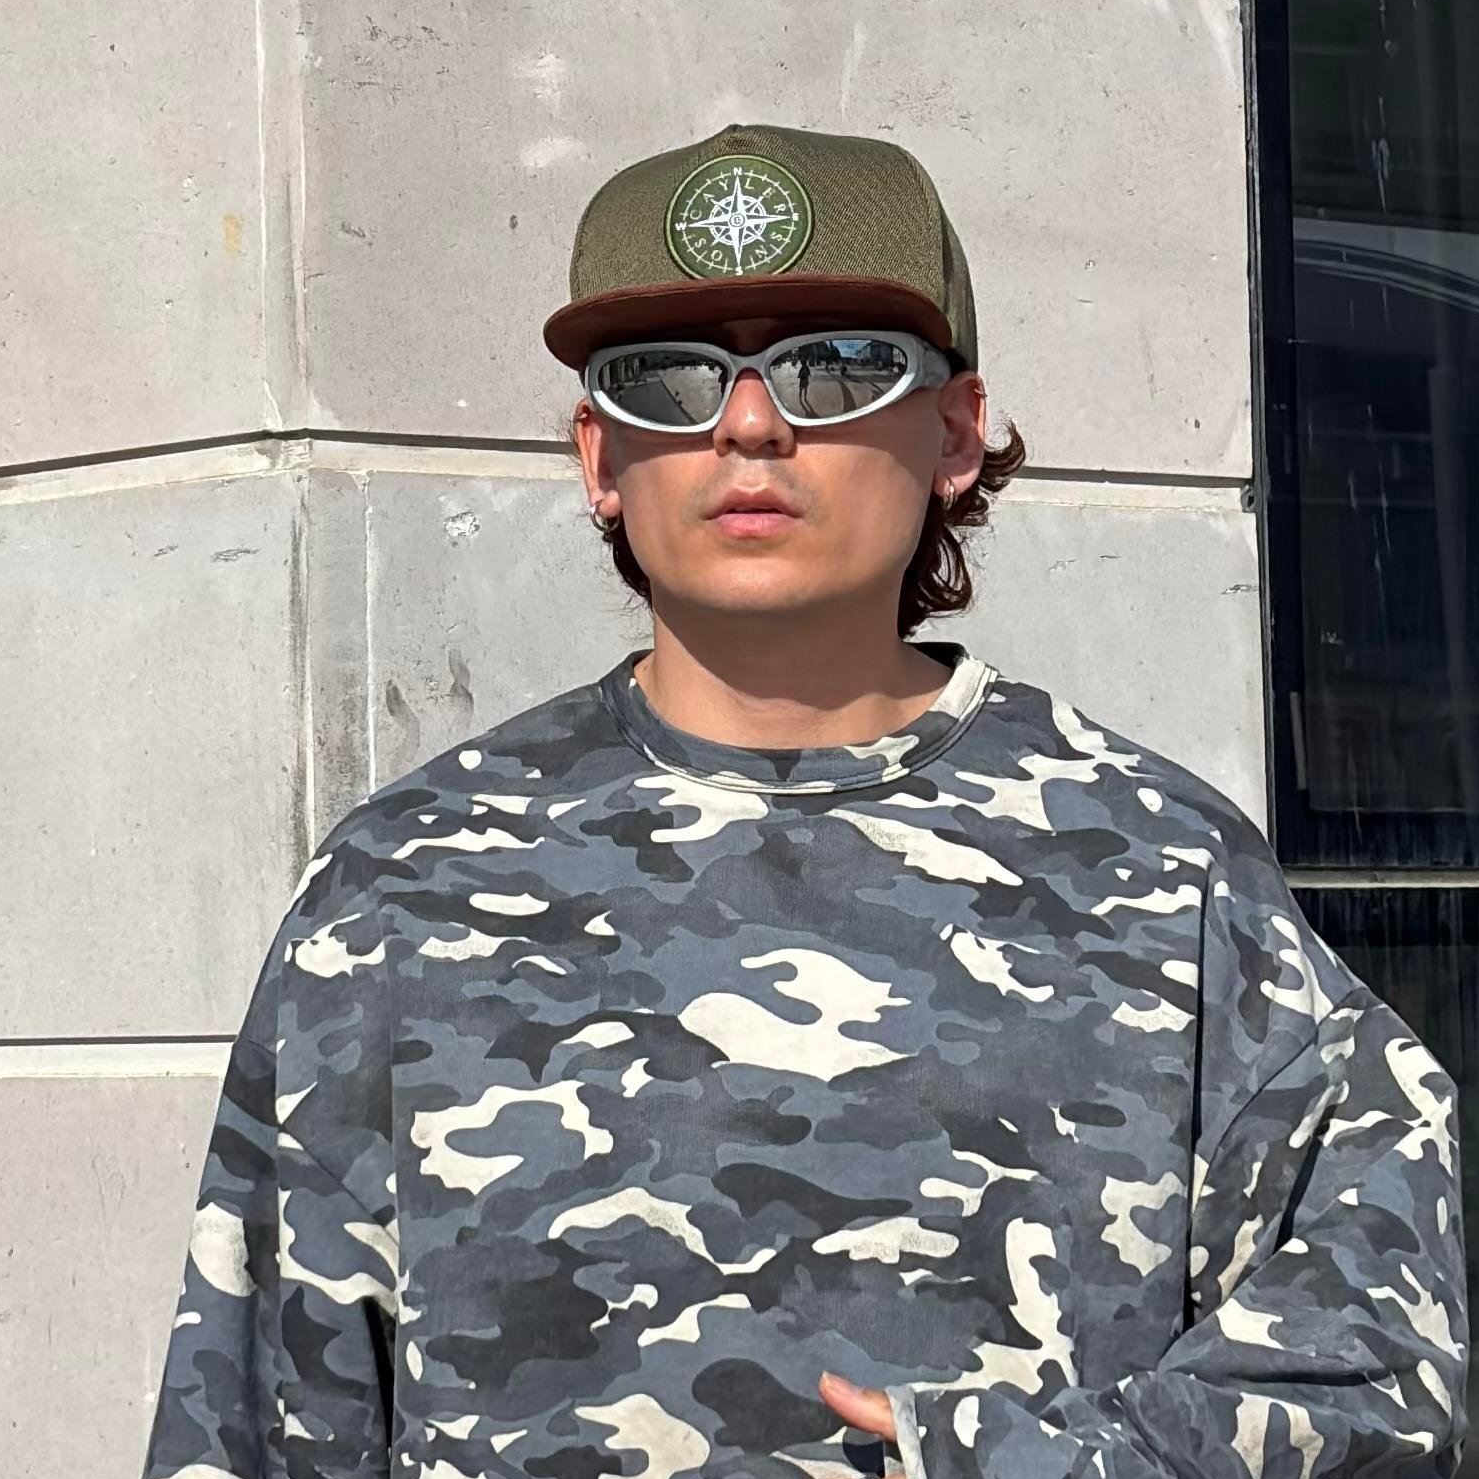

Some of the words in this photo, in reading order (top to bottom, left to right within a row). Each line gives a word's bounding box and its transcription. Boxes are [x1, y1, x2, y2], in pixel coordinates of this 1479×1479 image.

[733, 167, 743, 176] N
[689, 178, 787, 220] CAYLER
[675, 222, 686, 231] W
[694, 231, 783, 262] SONS
